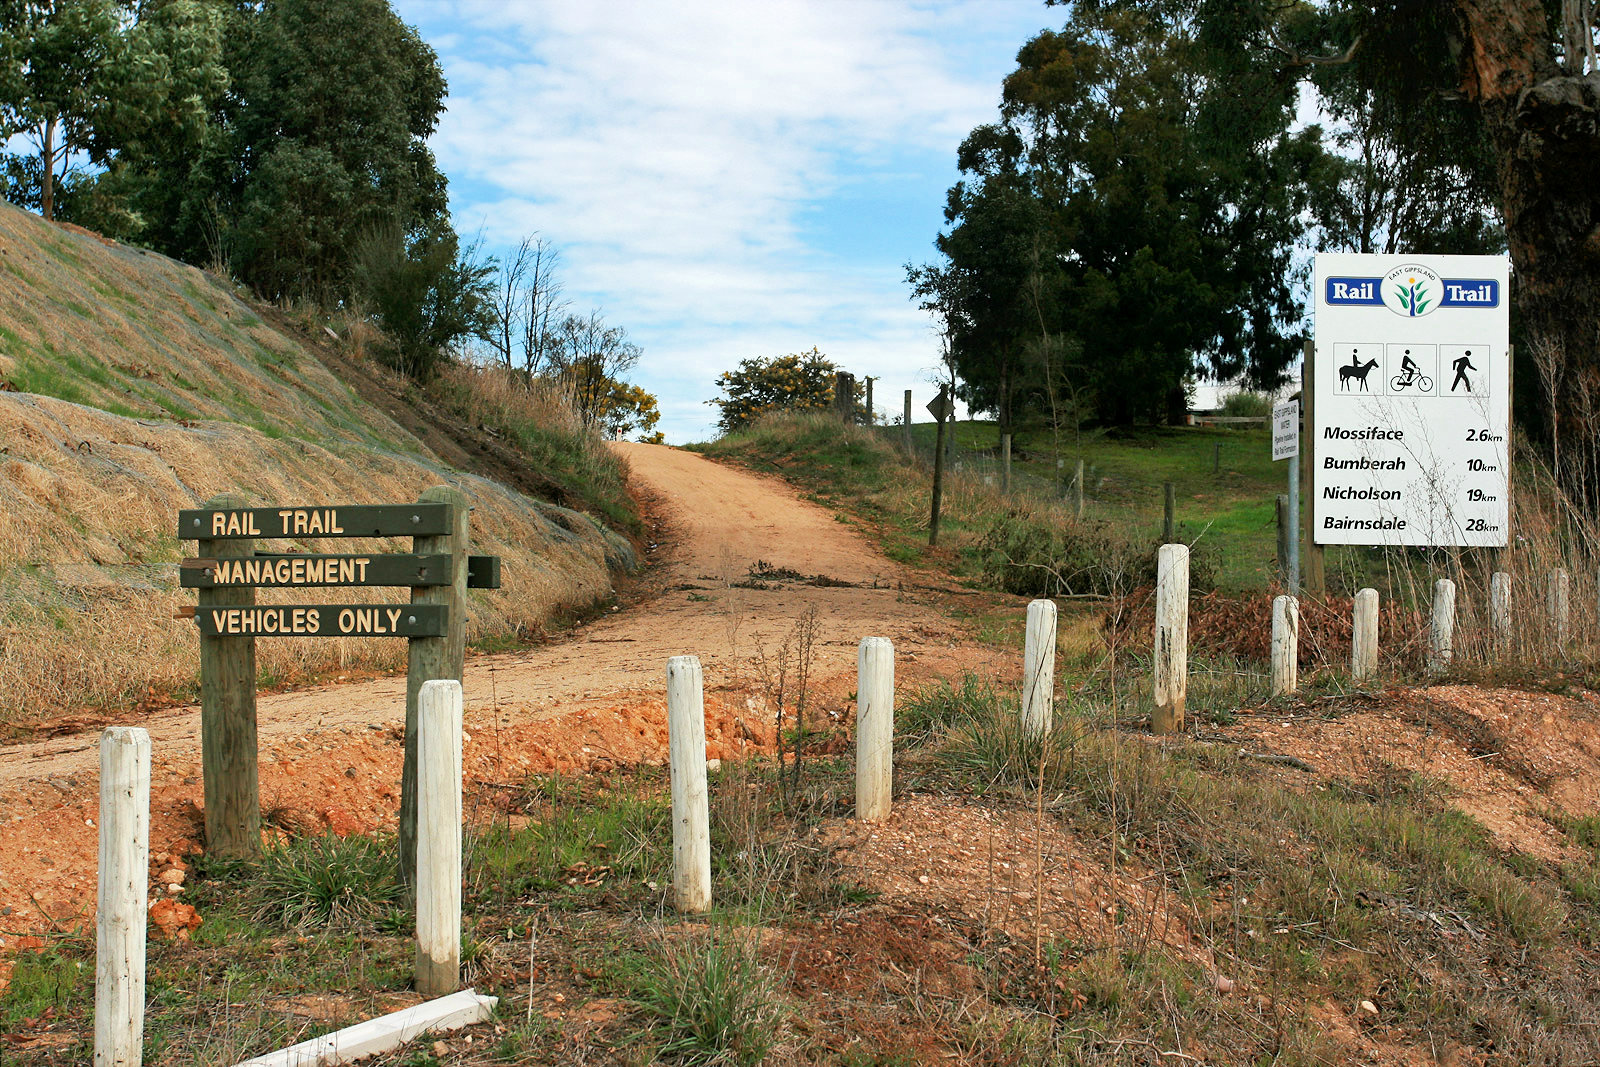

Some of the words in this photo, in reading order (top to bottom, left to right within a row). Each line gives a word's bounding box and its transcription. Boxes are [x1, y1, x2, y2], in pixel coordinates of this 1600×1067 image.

[1388, 269, 1403, 281] EAST
[1404, 267, 1436, 281] GIPPSLAND
[1332, 282, 1374, 300] Rail
[1446, 284, 1492, 302] Trail
[1323, 426, 1404, 441] Mossiface
[1465, 428, 1503, 442] 2.6km
[1323, 456, 1406, 470] Bumberah
[1466, 458, 1497, 472] 10km
[1323, 486, 1401, 500] Nicholson
[1466, 488, 1497, 502] 19km
[212, 511, 261, 536] RAIL
[279, 509, 344, 535] TRAIL
[1323, 516, 1406, 530] Bairnsdale
[1465, 518, 1499, 532] 28km
[213, 558, 370, 584] MANAGEMENT
[212, 608, 320, 634] VEHICLES
[338, 607, 402, 633] ONLY
